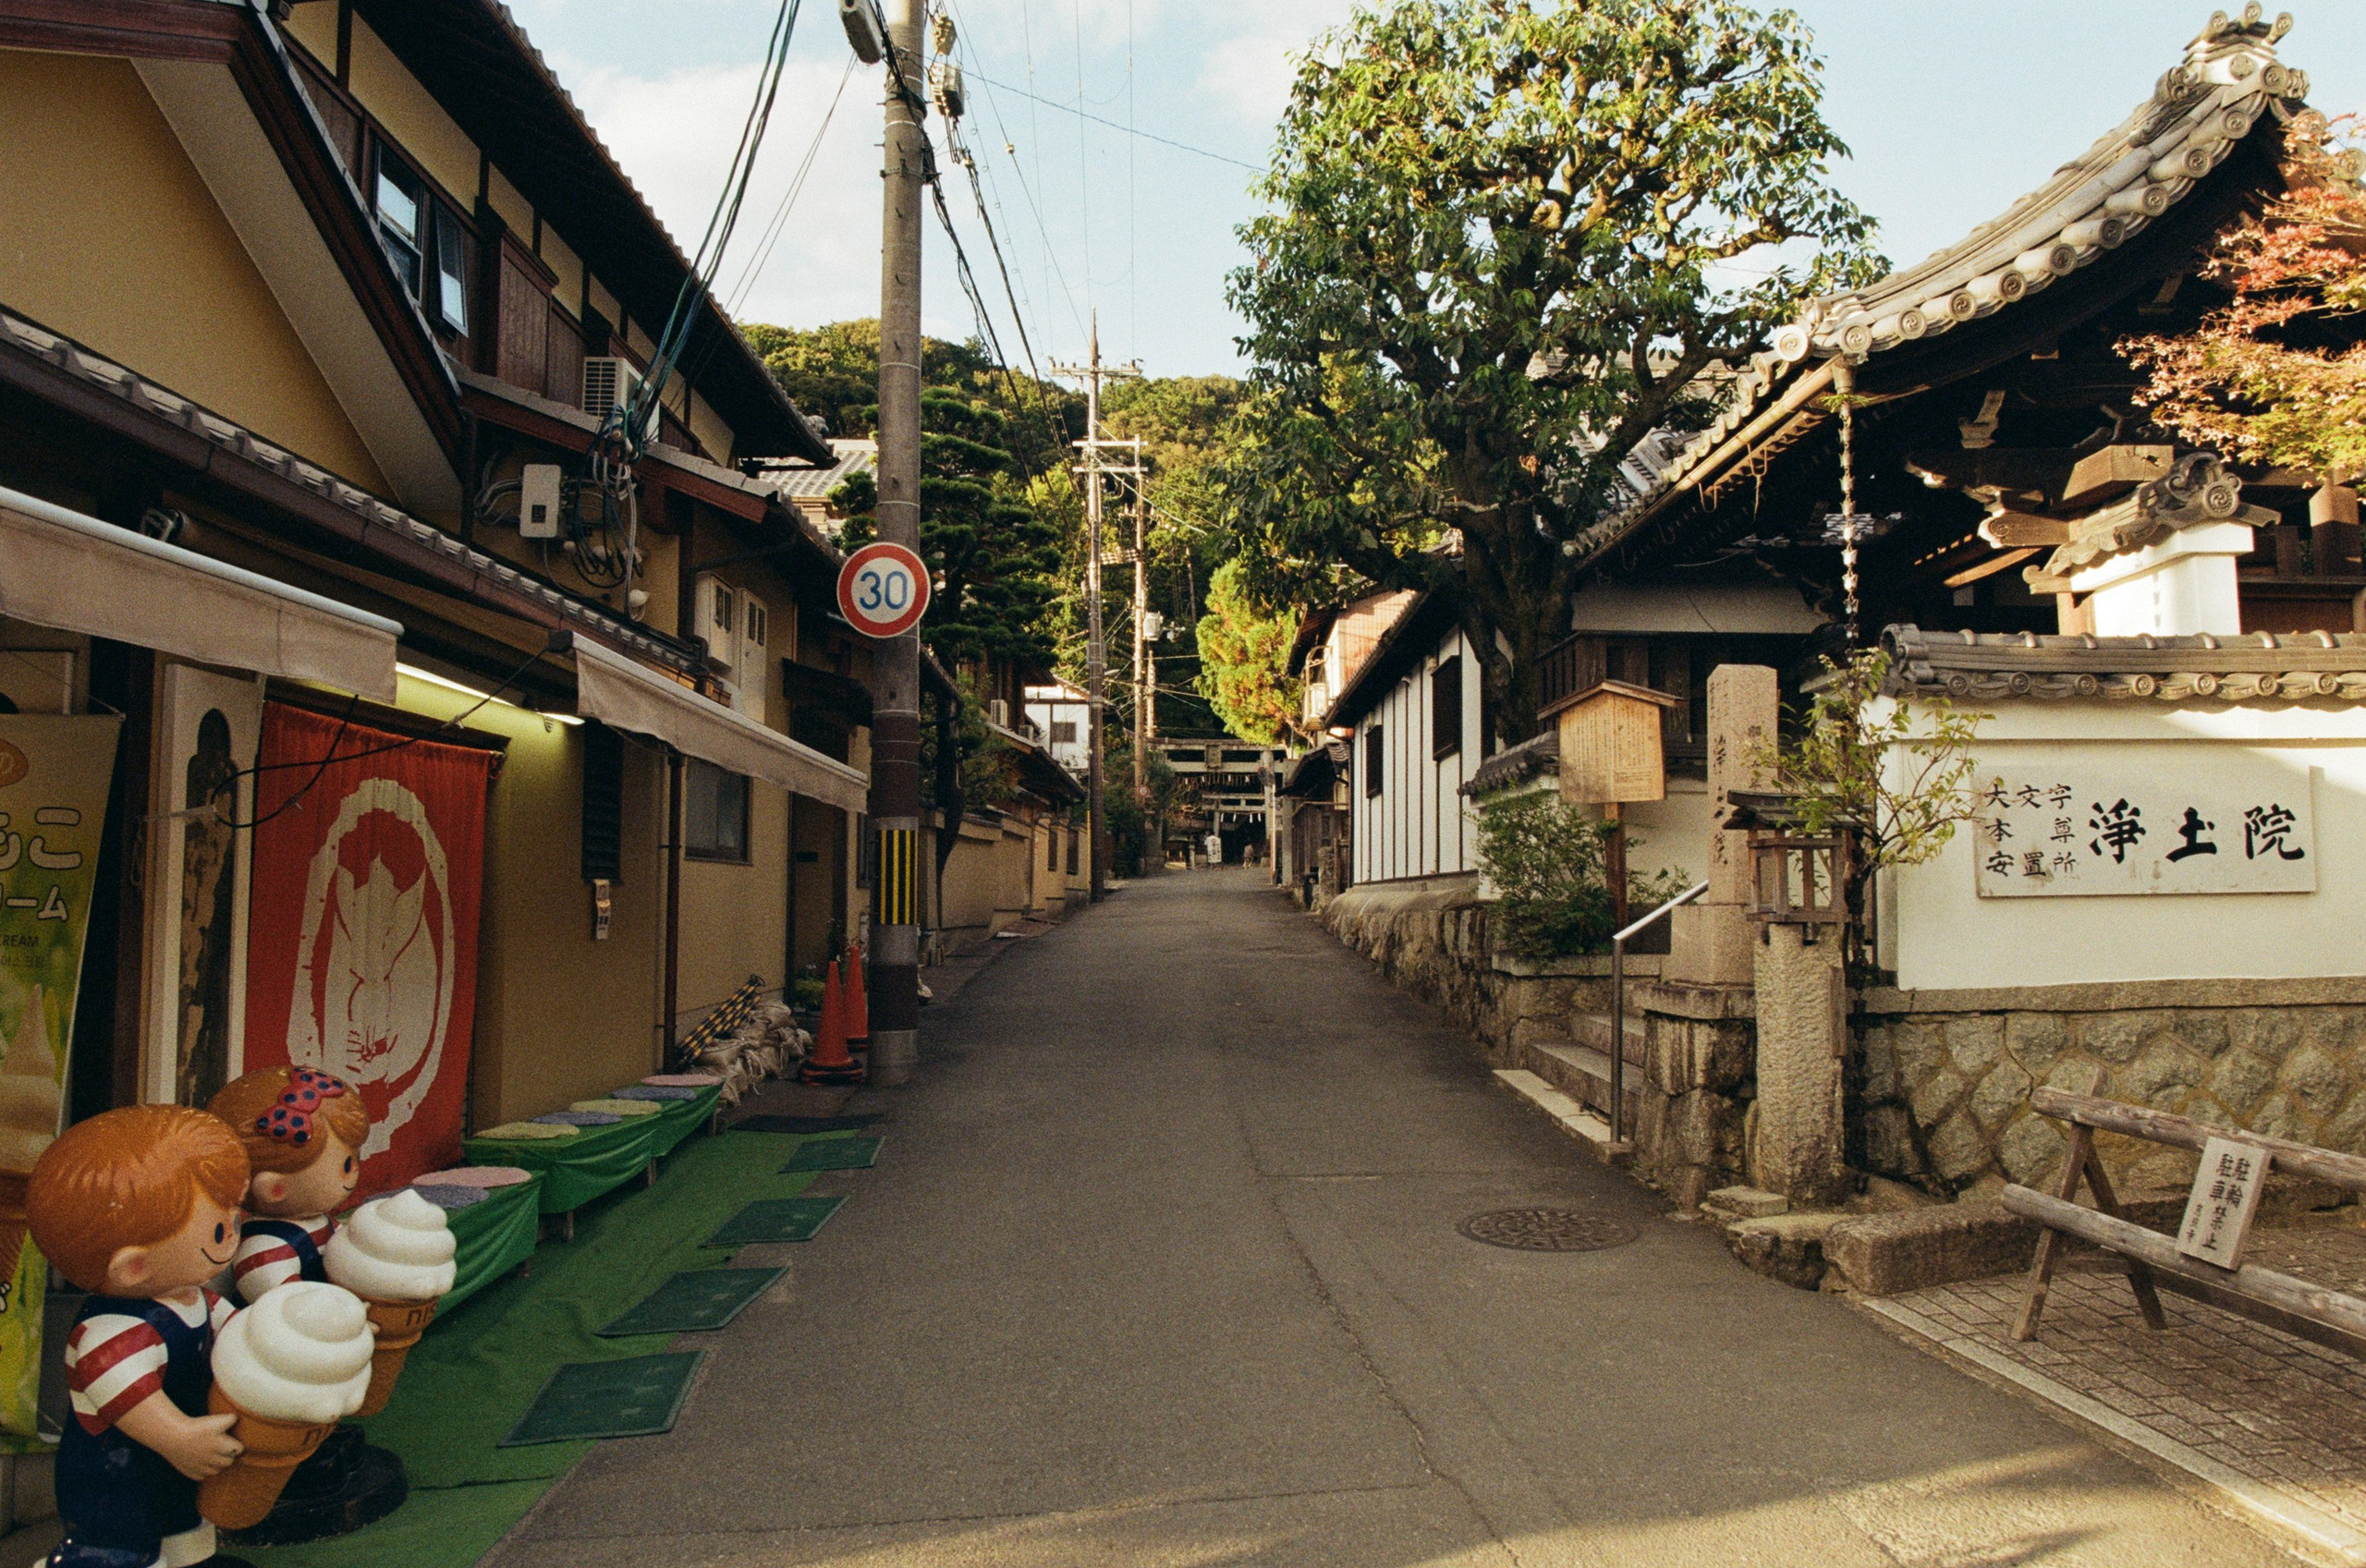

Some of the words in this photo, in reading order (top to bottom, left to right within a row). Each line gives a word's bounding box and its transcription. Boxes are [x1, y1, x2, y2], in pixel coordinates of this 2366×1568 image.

[860, 570, 907, 610] 30
[1984, 783, 2072, 809] 大文字
[1985, 850, 2077, 878] 安置所
[0, 882, 69, 922] ーム
